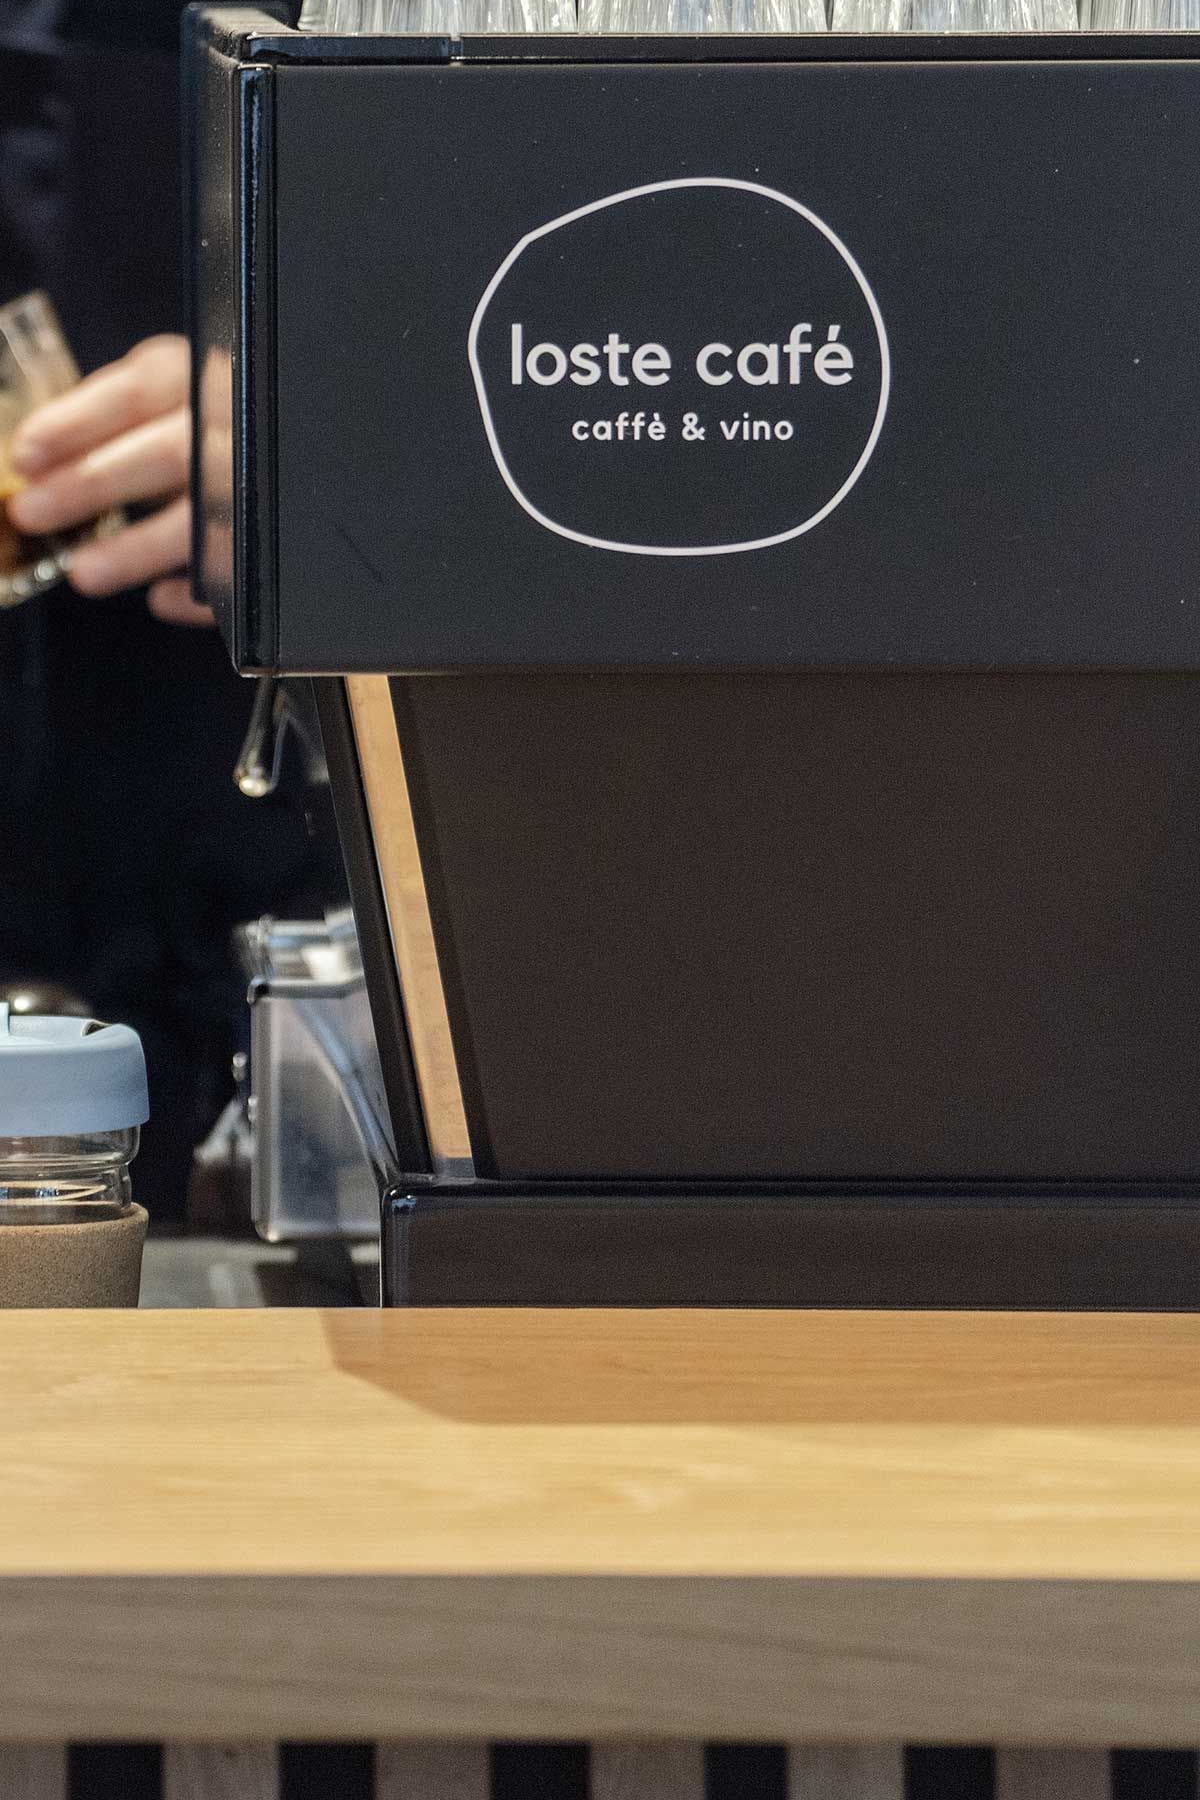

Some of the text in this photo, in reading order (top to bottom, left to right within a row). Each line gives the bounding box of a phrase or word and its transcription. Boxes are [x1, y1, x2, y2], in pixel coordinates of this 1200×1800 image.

[511, 322, 854, 386] loste café
[571, 412, 795, 441] caffè & vino
